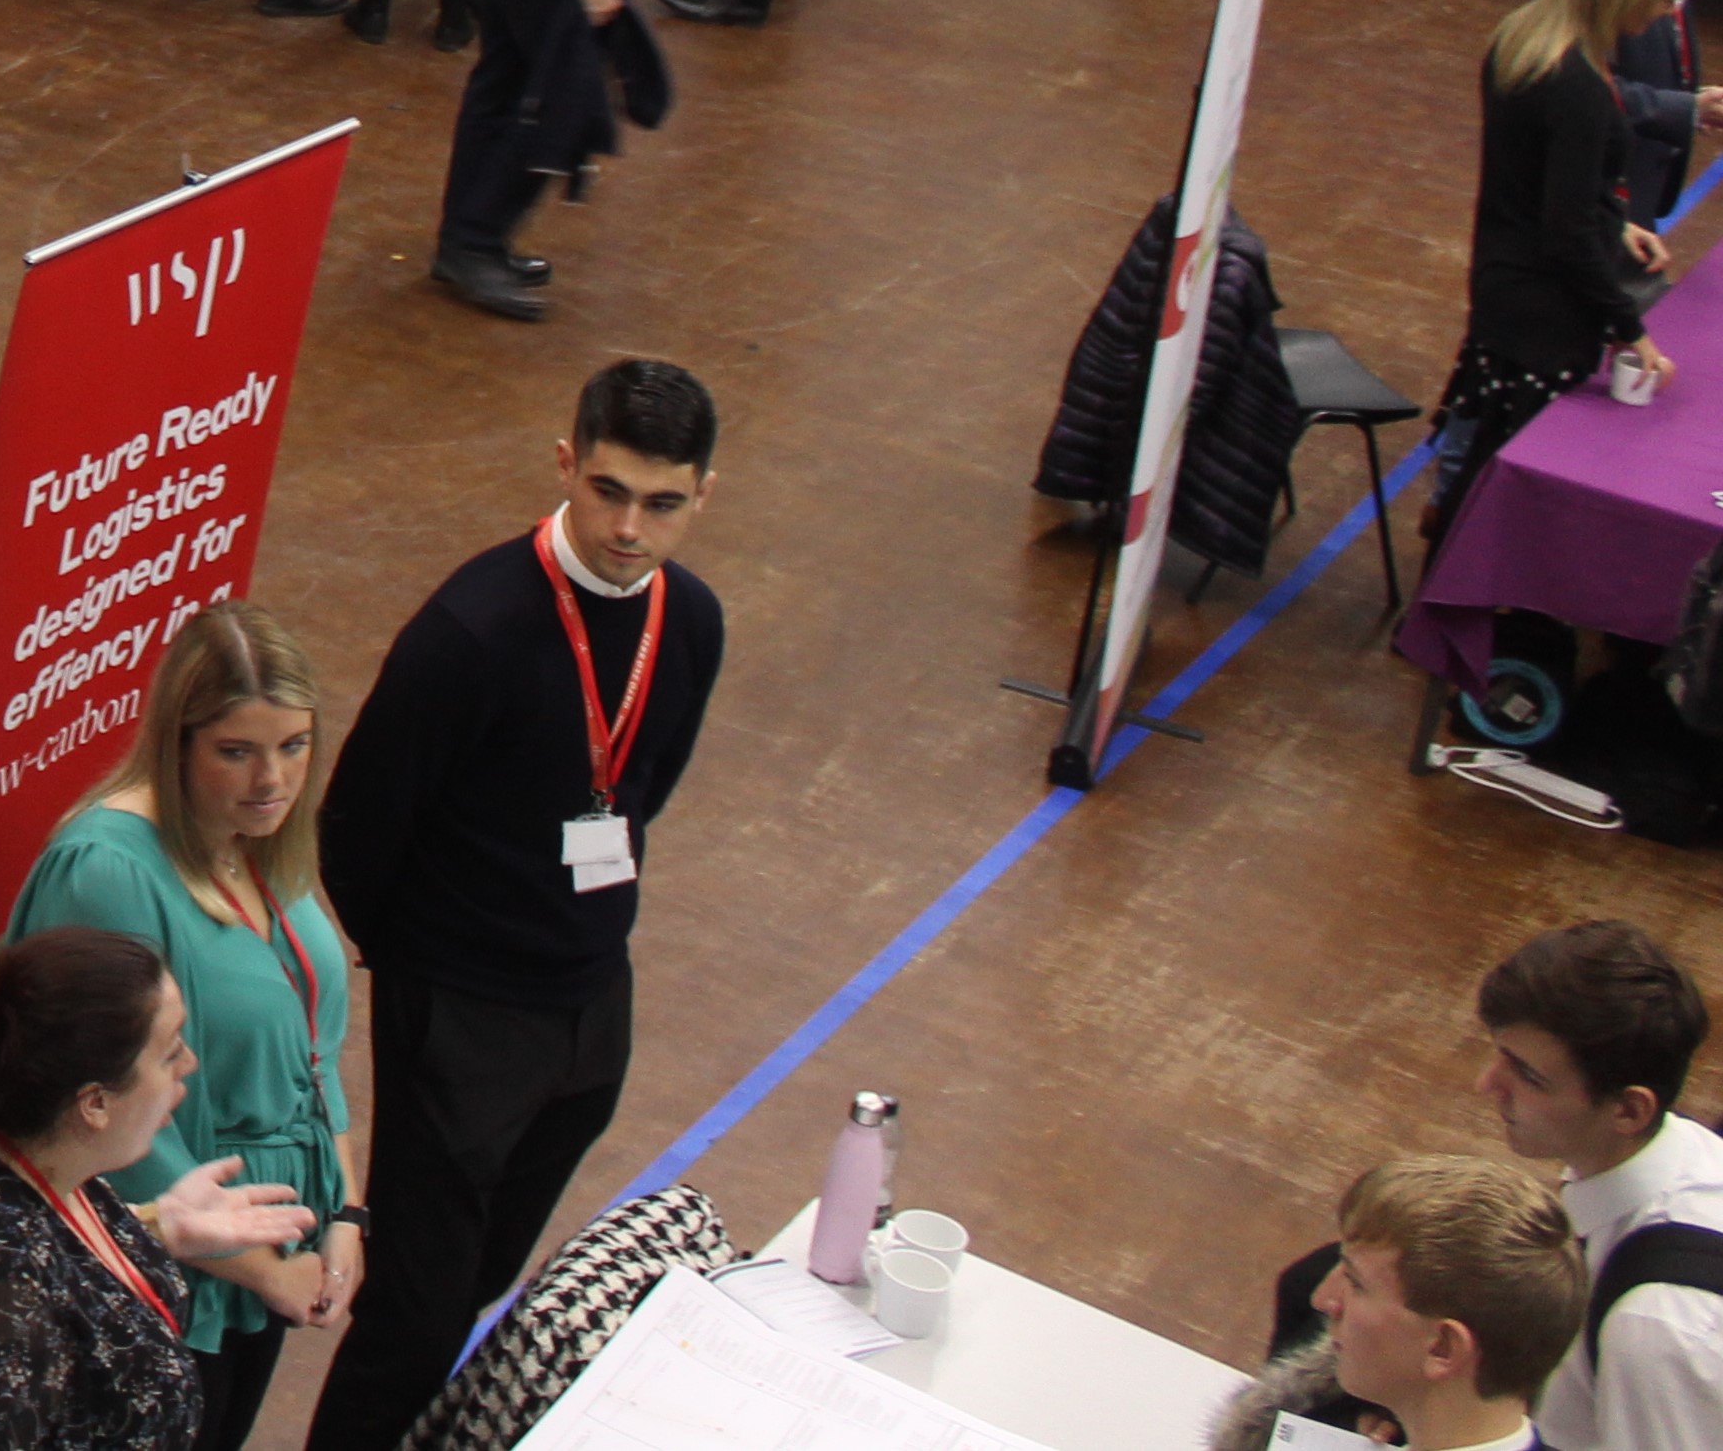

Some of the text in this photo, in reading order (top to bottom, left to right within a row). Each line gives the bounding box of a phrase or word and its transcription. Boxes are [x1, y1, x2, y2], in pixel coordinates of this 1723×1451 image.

[23, 371, 277, 528] Future Ready
[58, 462, 227, 576] Logistics
[13, 513, 247, 661] designed for
[2, 616, 159, 732] effiency
